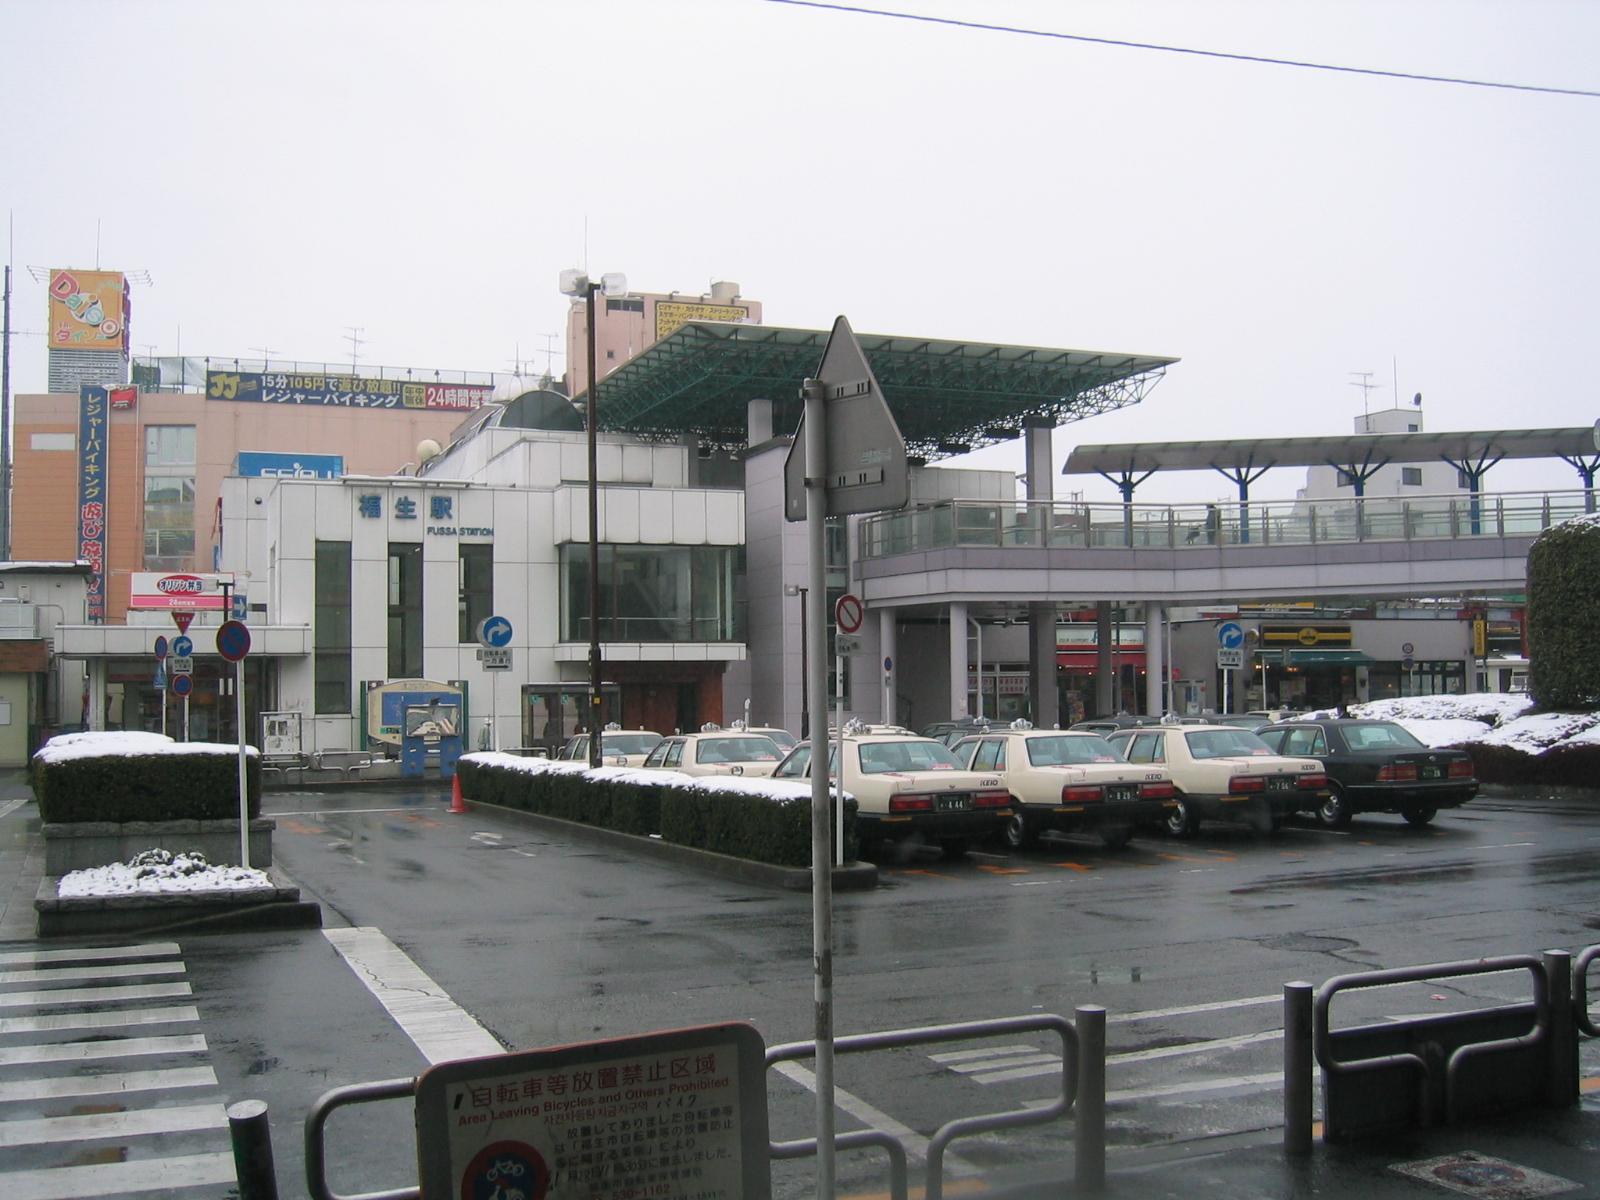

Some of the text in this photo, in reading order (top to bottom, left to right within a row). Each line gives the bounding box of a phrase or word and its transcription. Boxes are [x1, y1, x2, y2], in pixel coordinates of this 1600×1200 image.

[262, 389, 400, 408] レジャーバイキング
[85, 394, 102, 499] レジャーバイキング
[359, 495, 454, 520] 福生駅
[427, 527, 494, 536] FUSSA STATION
[160, 580, 203, 592] オリジン弁当
[471, 1053, 717, 1108] 自転車等放置禁止区域
[459, 1077, 729, 1126] Area Leaving Bicycles and Others Prohibited
[612, 1183, 670, 1200] 530-1162
